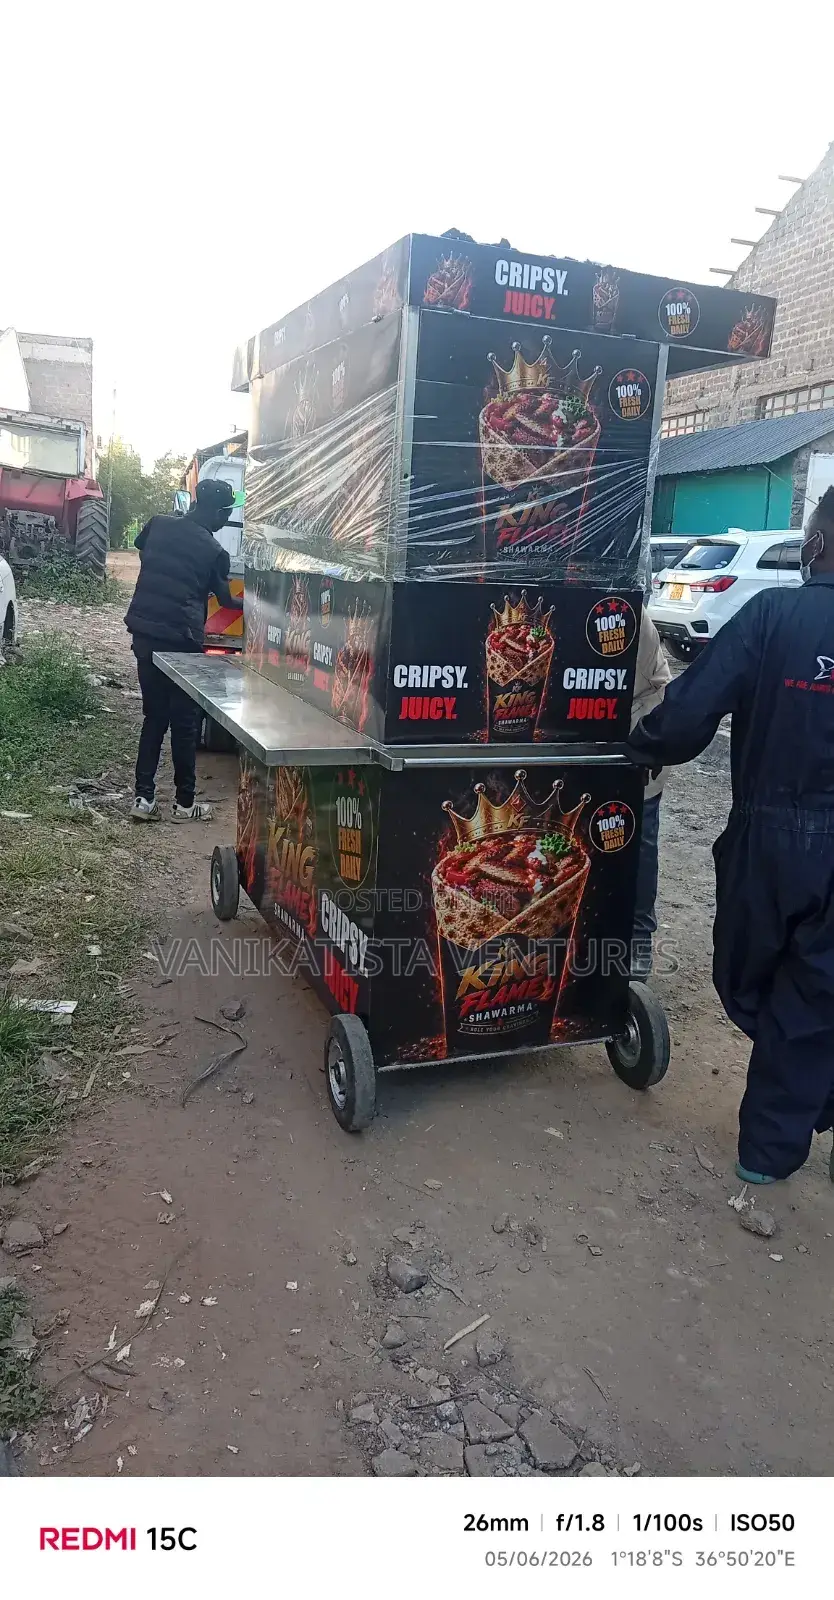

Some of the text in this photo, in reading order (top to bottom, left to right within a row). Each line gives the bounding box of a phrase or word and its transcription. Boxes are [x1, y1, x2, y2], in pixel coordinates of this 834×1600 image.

[495, 259, 569, 296] CRIPSY.
[503, 290, 556, 320] JUICY.
[665, 302, 691, 317] 100%
[667, 315, 691, 326] FRESH
[615, 384, 642, 399] 100%
[619, 396, 641, 408] FRESH
[621, 405, 641, 418] DAILY
[594, 613, 626, 633] 100%
[598, 627, 625, 643] FRESH
[601, 639, 625, 654] DAILY
[393, 664, 469, 689] CRIPSY.
[562, 667, 628, 691] CRIPSY.
[399, 696, 458, 720] JUICY.
[566, 697, 618, 720] JUICY.
[336, 796, 362, 830] 100%
[507, 812, 531, 829] KF
[596, 814, 625, 833] 100%
[600, 827, 625, 842] FRESH
[603, 837, 625, 851] DAILY
[266, 821, 316, 890] KING
[455, 951, 549, 1001] KING
[468, 1002, 534, 1023] SHAWARMA
